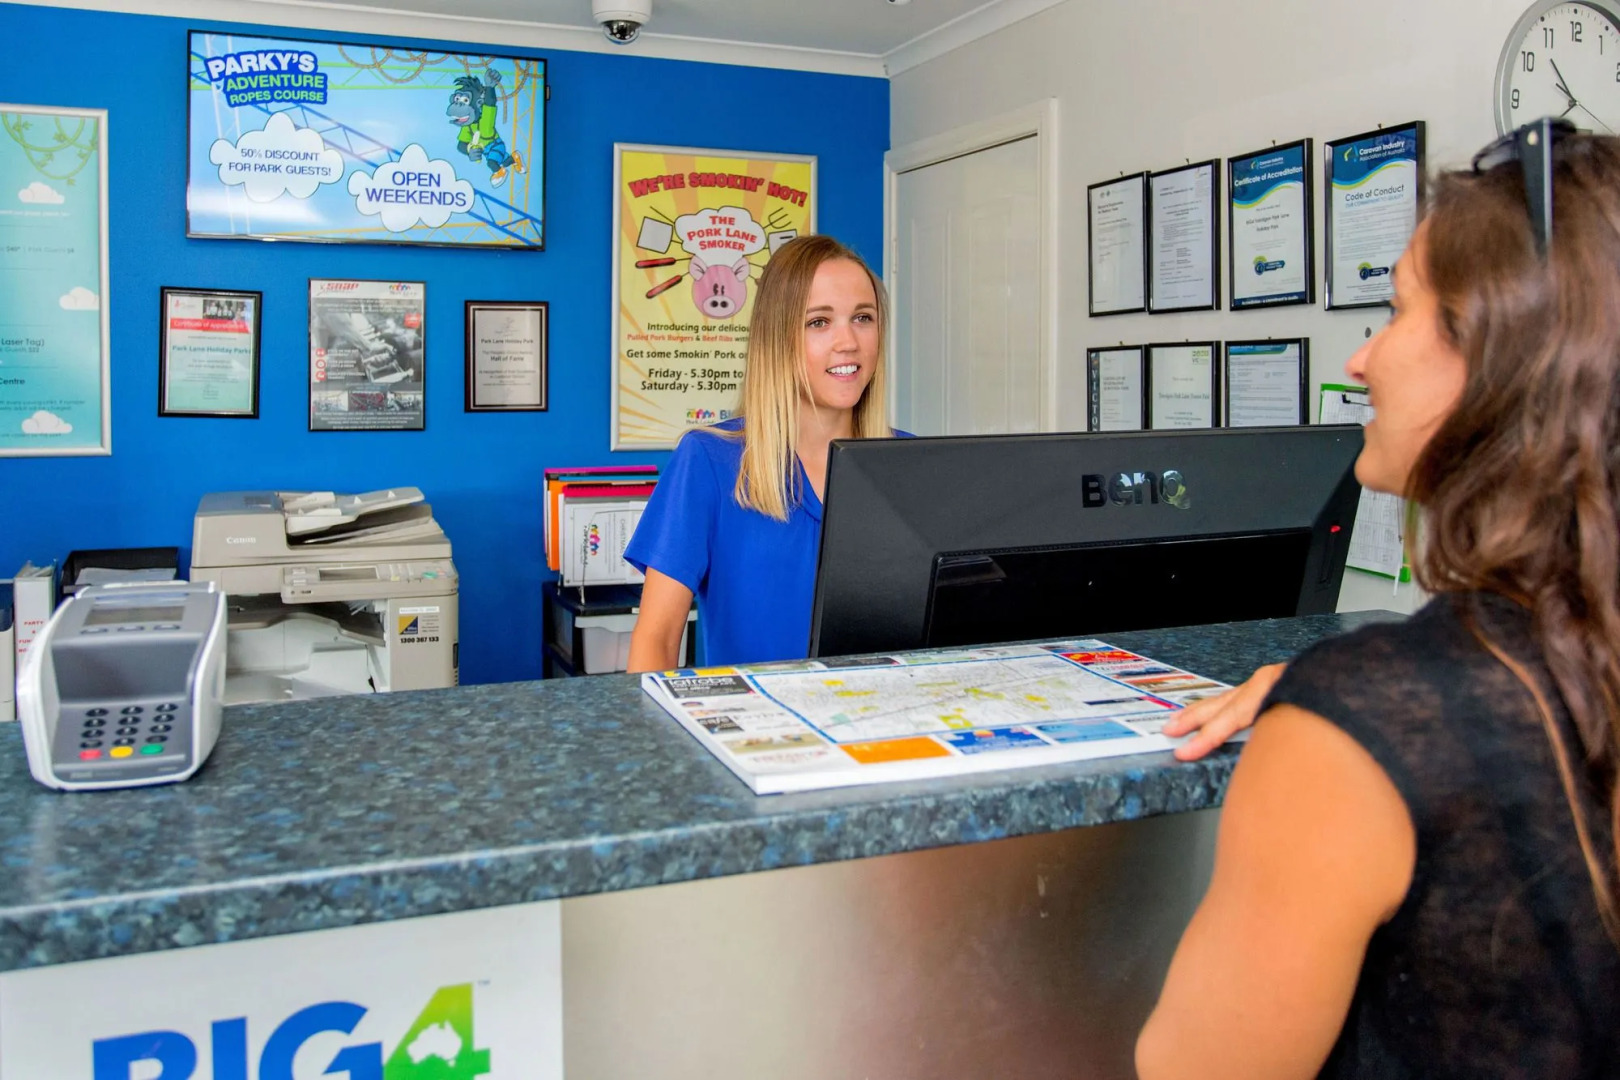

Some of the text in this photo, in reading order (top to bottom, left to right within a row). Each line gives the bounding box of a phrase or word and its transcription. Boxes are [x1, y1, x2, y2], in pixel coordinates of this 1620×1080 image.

[1543, 28, 1554, 48] 11
[1570, 21, 1582, 42] 12
[1598, 35, 1602, 55] 1
[207, 52, 315, 79] PARKY'S
[1522, 51, 1534, 72] 10
[226, 74, 324, 91] ADVENTURE
[230, 90, 324, 104] ROPES COURSE
[1512, 89, 1520, 109] 9
[241, 148, 320, 162] 50% DISCOUNT
[1359, 140, 1406, 155] Caravan Industry
[228, 162, 332, 176] FOR PARK GUESTS!
[392, 171, 441, 188] OPEN
[365, 188, 467, 207] WEEKENDS
[628, 172, 808, 208] WE'RE SMOKIN' HOT!
[1345, 184, 1404, 202] Code of Conduct
[709, 215, 736, 226] THE
[647, 322, 700, 334] Introducing
[26, 338, 45, 347] Tag)
[667, 334, 694, 342] Burgers
[626, 349, 644, 358] Get
[674, 350, 712, 360] Smokin'
[714, 350, 737, 359] Pork
[648, 368, 682, 380] Friday
[690, 368, 730, 380] 5.30pm
[733, 370, 744, 378] to
[640, 380, 688, 392] Saturday
[696, 381, 737, 393] 5.30pm
